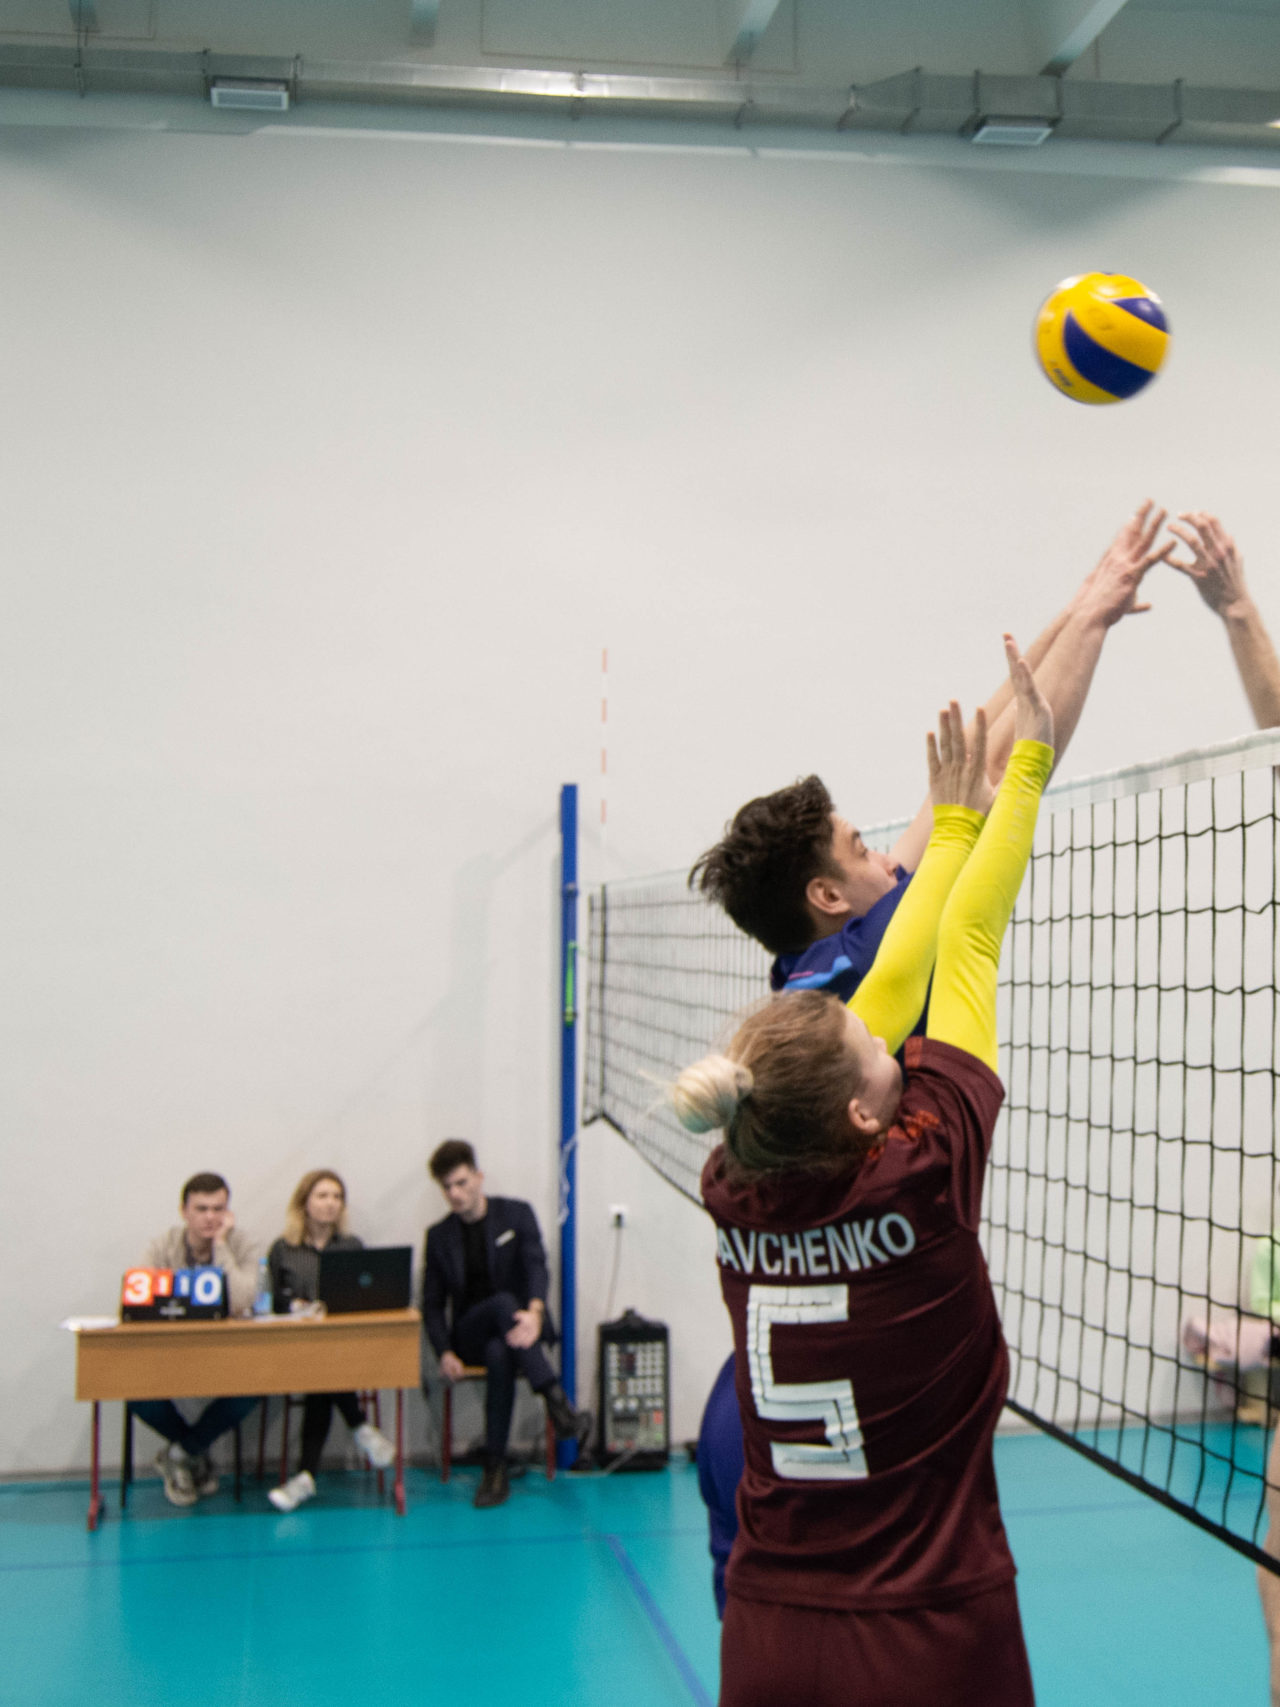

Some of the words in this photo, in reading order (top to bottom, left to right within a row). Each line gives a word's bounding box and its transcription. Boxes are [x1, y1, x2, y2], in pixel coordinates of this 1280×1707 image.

[717, 1212, 916, 1277] AVCHENKO
[125, 1271, 152, 1304] 3
[194, 1270, 222, 1304] 0
[747, 1283, 870, 1480] 5
